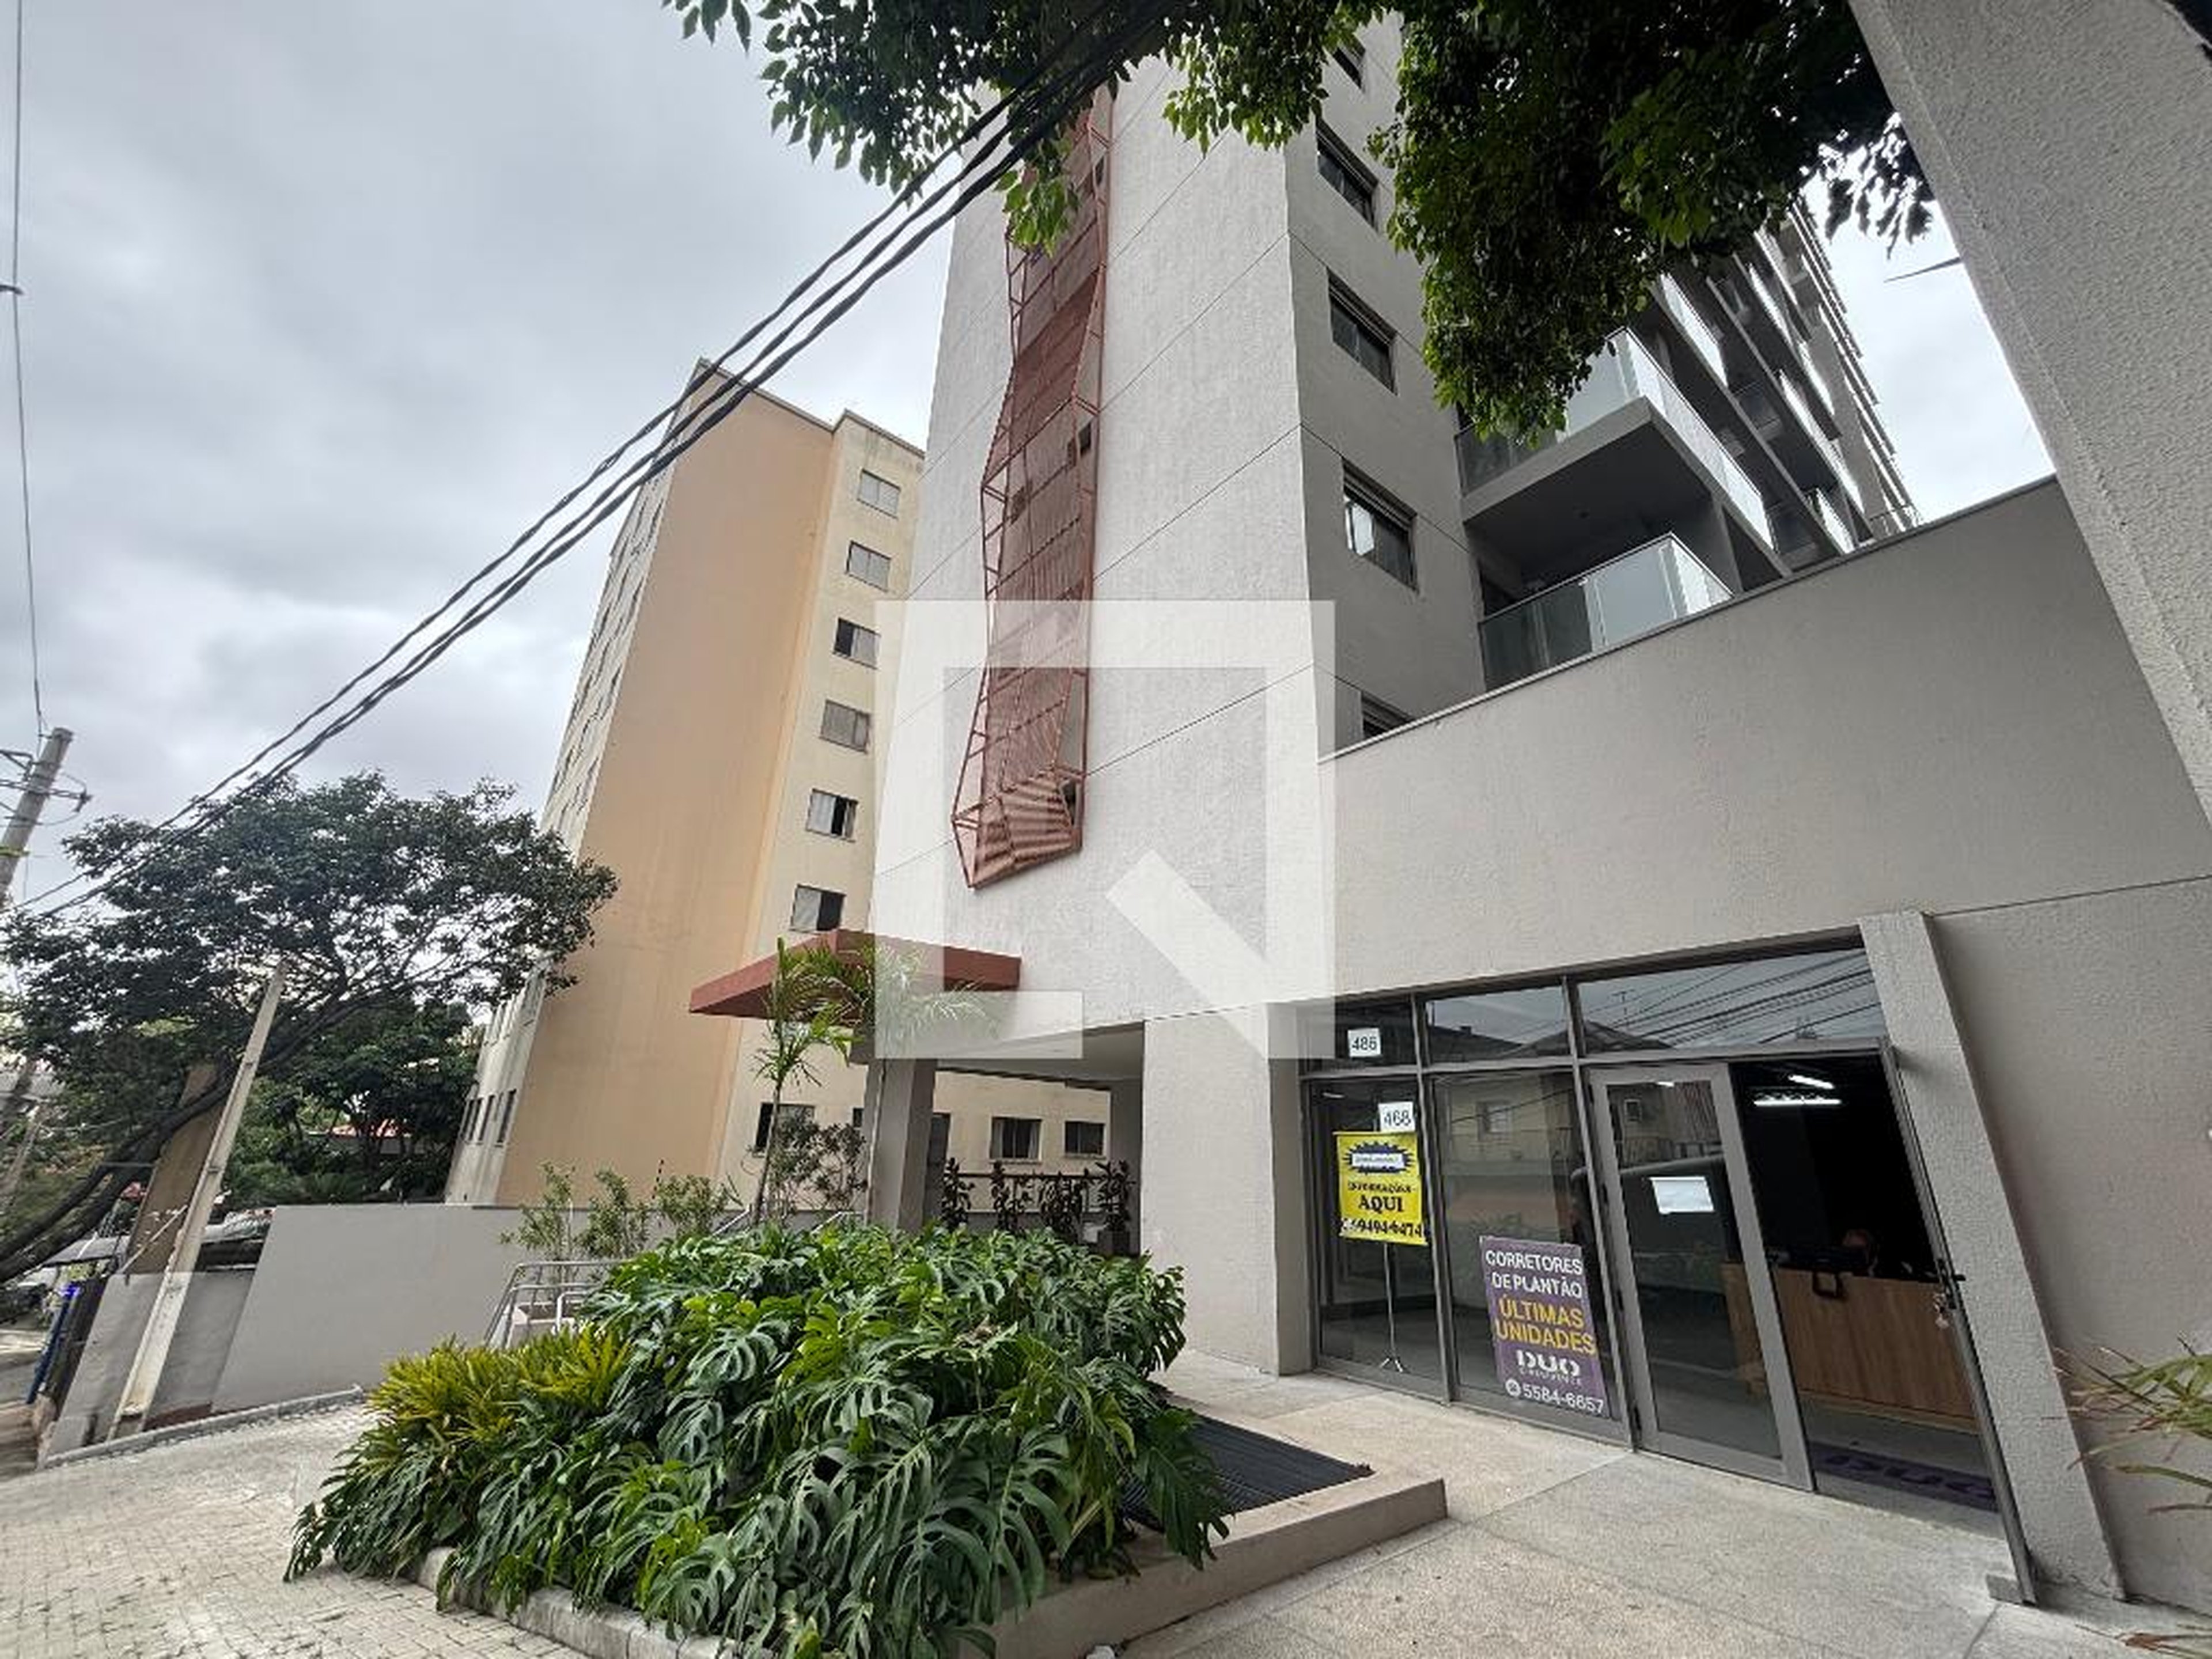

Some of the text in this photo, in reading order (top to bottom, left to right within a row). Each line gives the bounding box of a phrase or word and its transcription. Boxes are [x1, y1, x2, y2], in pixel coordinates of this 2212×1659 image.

[1384, 1110, 1411, 1126] 468
[1358, 1194, 1404, 1214] AQUI
[1486, 1249, 1583, 1275] CORRETORES
[1491, 1271, 1582, 1299] DE PLANTÃO
[1499, 1293, 1584, 1328] ÚLTIMAS
[1495, 1319, 1597, 1355] UNIDADES
[1516, 1350, 1580, 1377] DUO
